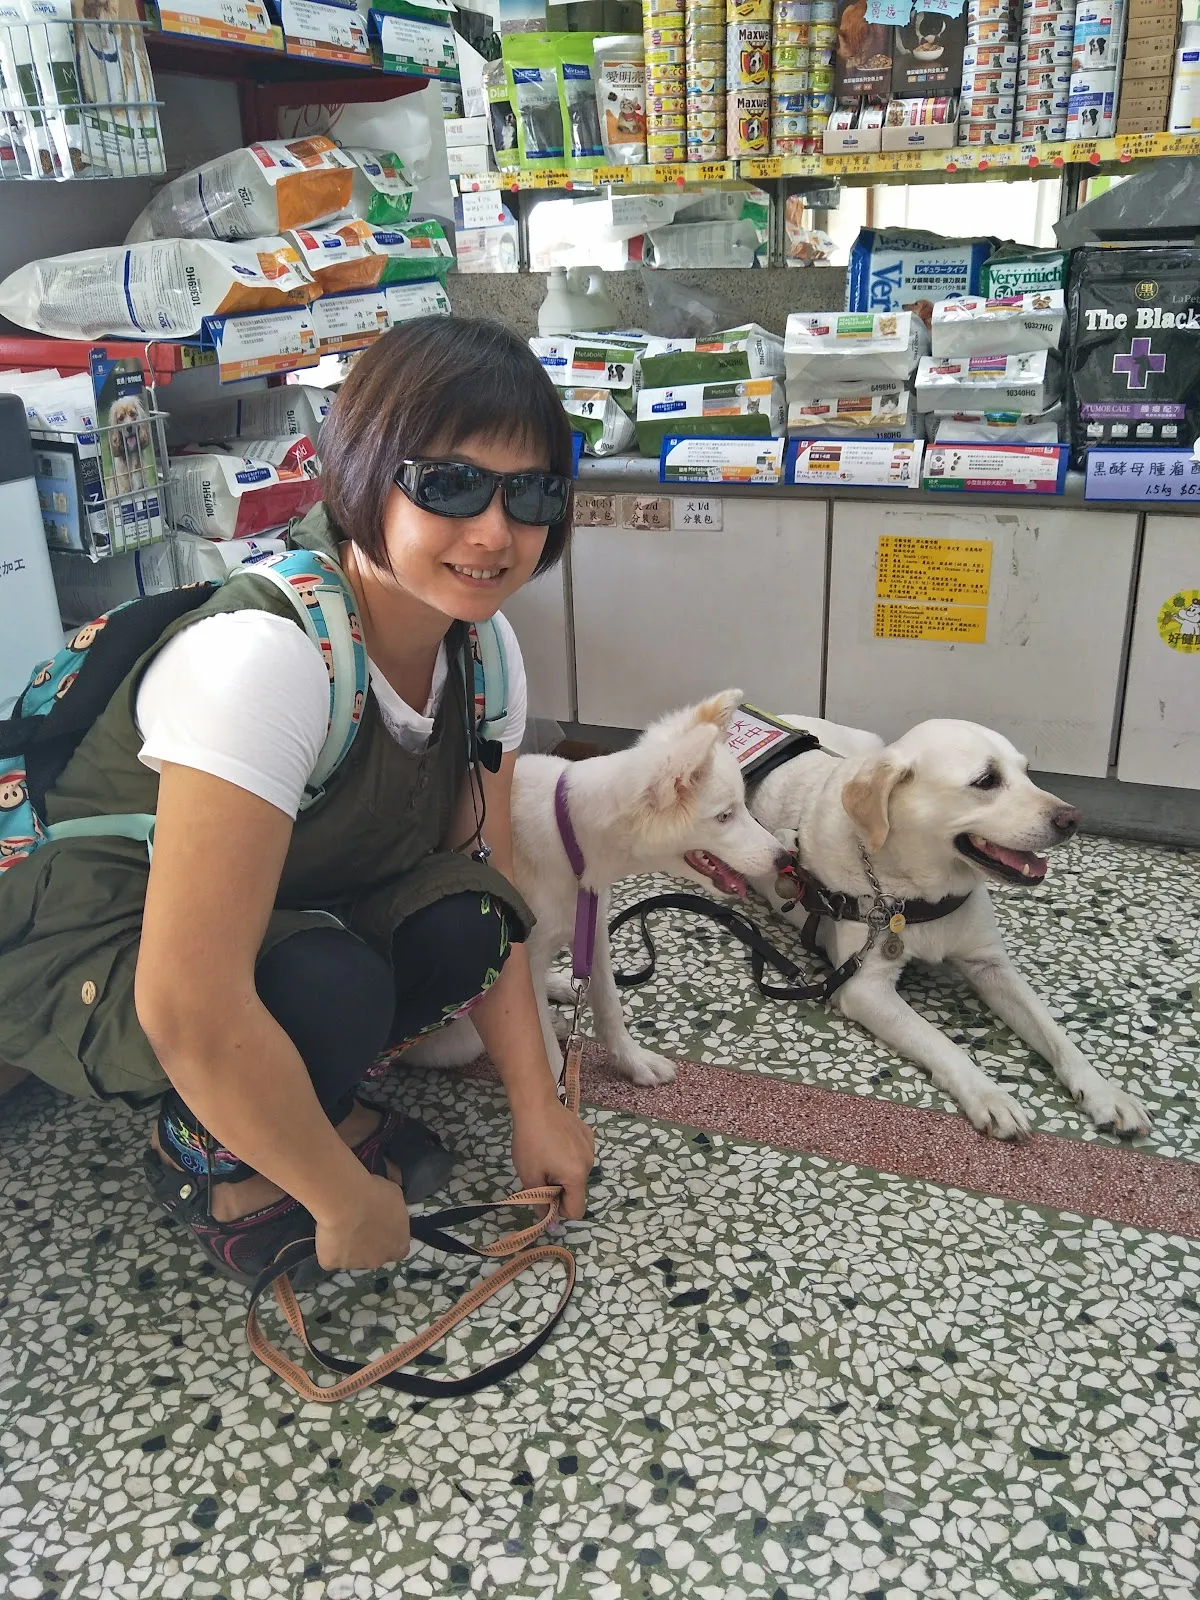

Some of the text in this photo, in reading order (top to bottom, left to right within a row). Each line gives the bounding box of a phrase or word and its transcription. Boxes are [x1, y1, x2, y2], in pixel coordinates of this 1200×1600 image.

[605, 71, 645, 84] 愛明亮
[916, 265, 966, 274] レギュラータイプ
[990, 267, 1063, 286] Verymuch
[995, 287, 1012, 299] 54
[1085, 308, 1200, 330] The Black
[1024, 322, 1054, 332] 10327HG
[574, 350, 604, 358] Metabolic
[870, 383, 897, 392] 6498HG
[1006, 389, 1036, 397] 10340HG
[202, 480, 214, 518] 10075HG
[686, 502, 696, 511] 犬
[631, 514, 661, 524] 分裝包
[683, 515, 713, 524] 分裝包
[0, 558, 26, 577] 加工
